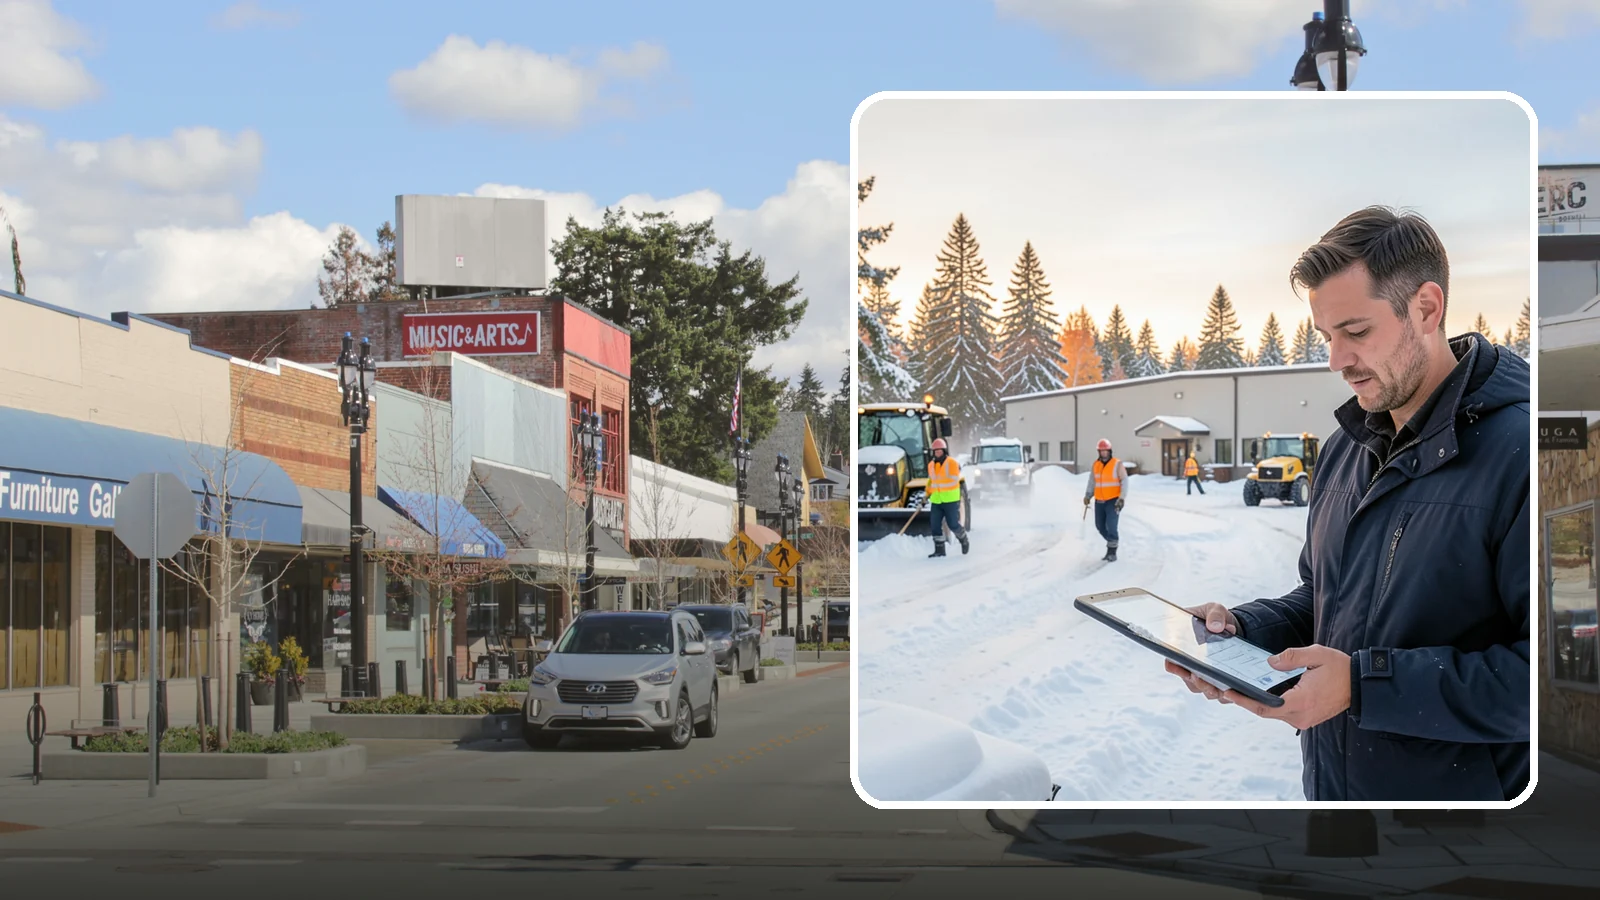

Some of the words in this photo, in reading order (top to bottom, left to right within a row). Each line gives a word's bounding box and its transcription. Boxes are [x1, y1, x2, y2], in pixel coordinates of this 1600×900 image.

[408, 323, 519, 348] MUSIC&ARTS
[0, 471, 79, 515] Furniture
[89, 482, 121, 519] Gal
[453, 563, 479, 574] SUSHI
